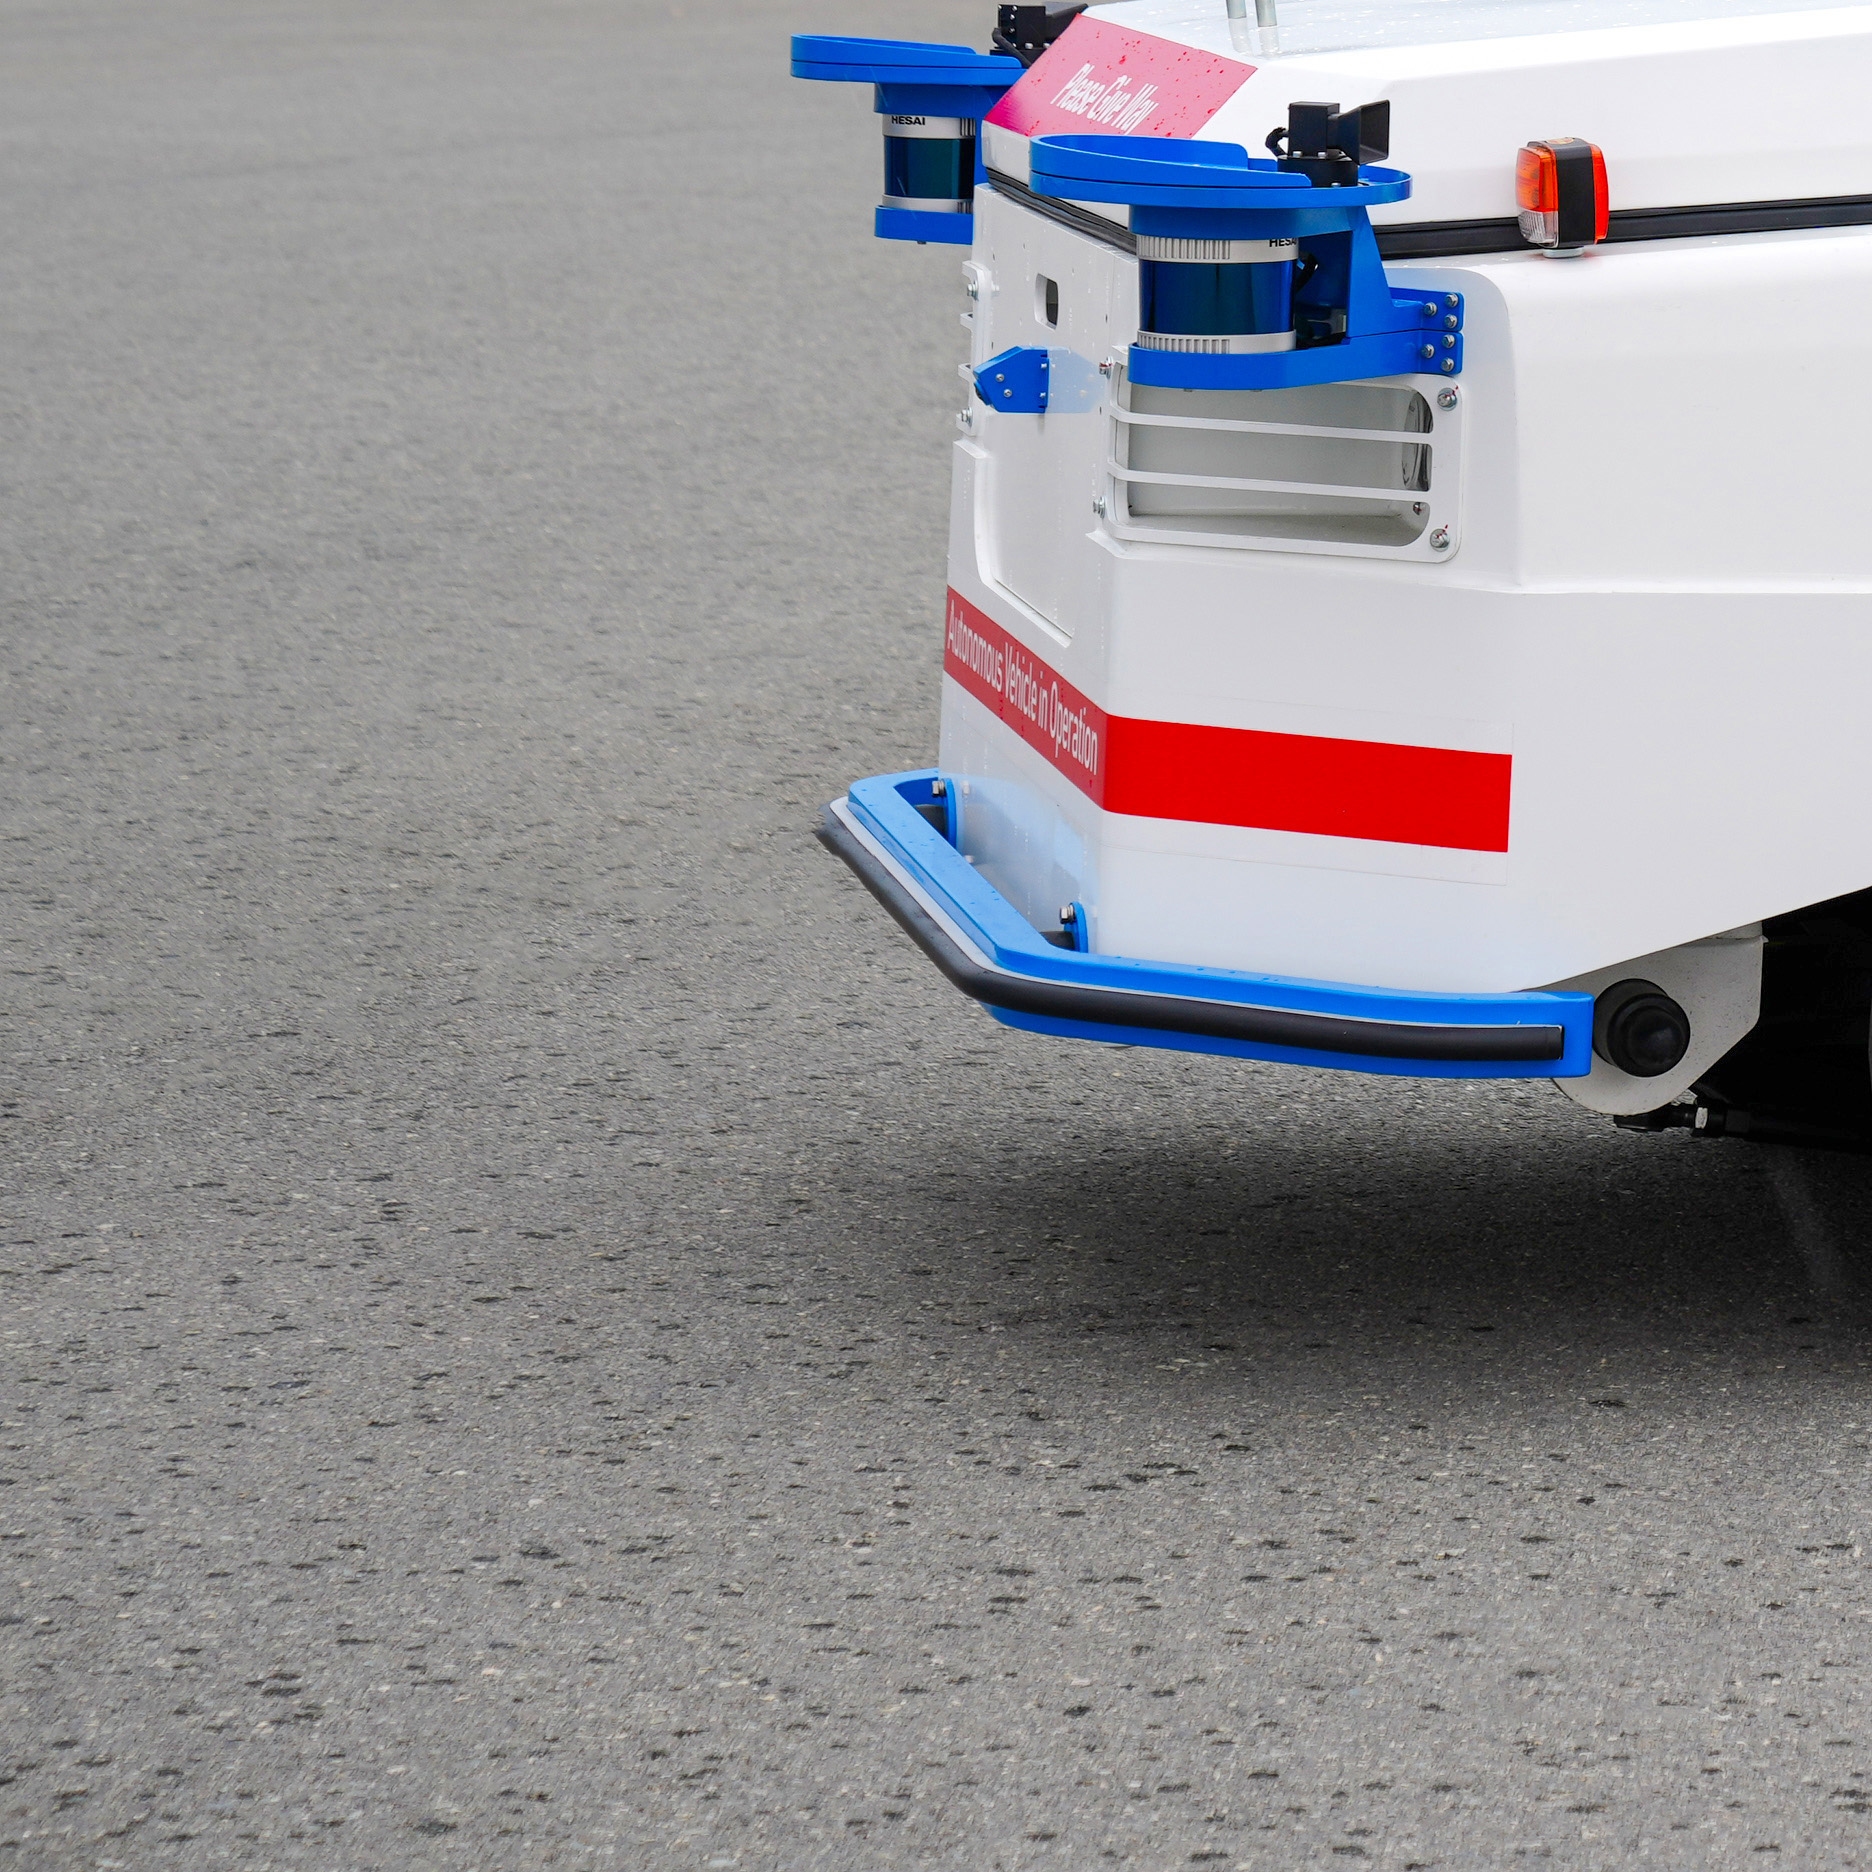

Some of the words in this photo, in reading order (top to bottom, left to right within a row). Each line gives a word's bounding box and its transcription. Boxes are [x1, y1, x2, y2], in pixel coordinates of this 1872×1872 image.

[891, 115, 926, 126] HESAI
[1049, 63, 1106, 116] Please
[1086, 74, 1133, 125] Give
[1110, 82, 1160, 136] Way
[946, 599, 1003, 693] Autonomous
[1004, 641, 1038, 722] Vehicle
[1037, 670, 1049, 732] in
[1049, 680, 1099, 776] Operation
